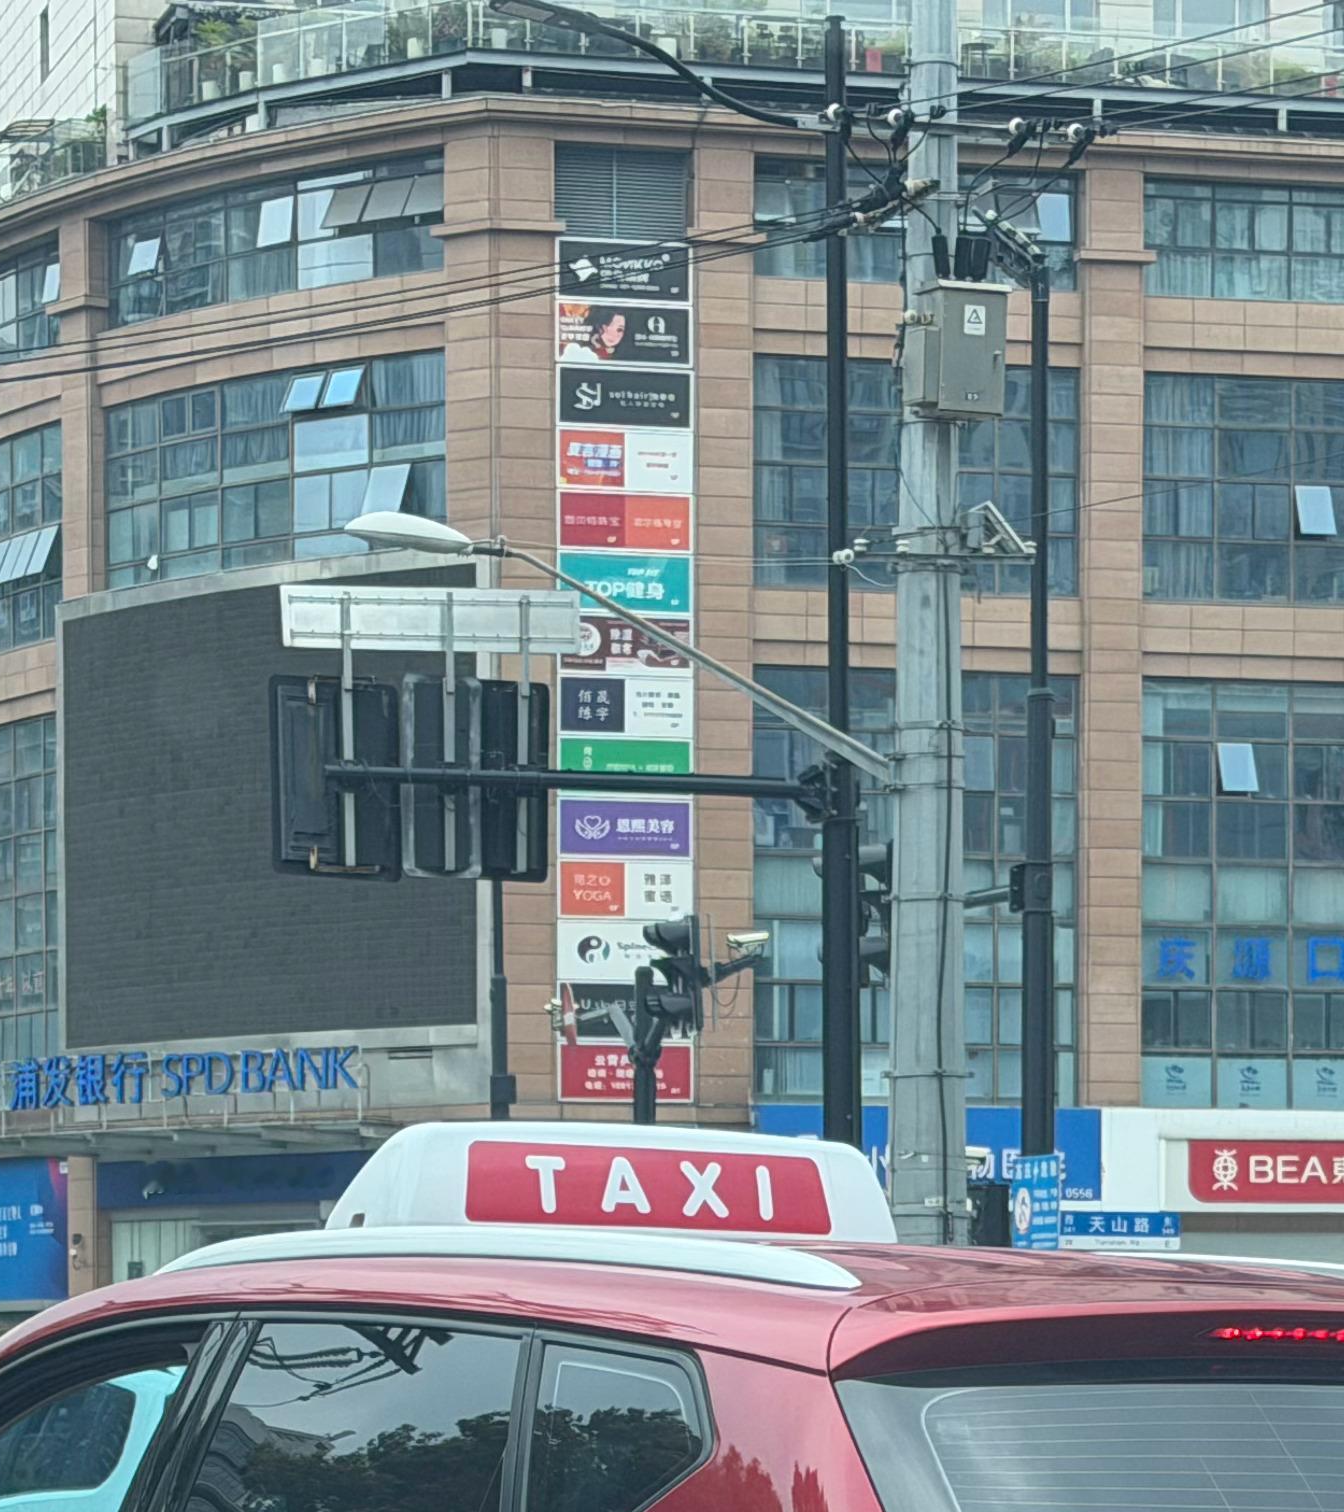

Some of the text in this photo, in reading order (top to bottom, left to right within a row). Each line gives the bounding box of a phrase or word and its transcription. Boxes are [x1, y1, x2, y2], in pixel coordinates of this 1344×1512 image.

[572, 889, 612, 902] YOGA
[7, 1046, 359, 1112] 浦发银行 SPD BANK
[1249, 1155, 1328, 1184] BEA
[525, 1154, 774, 1221] TAXI
[1088, 1216, 1149, 1233] 天山路
